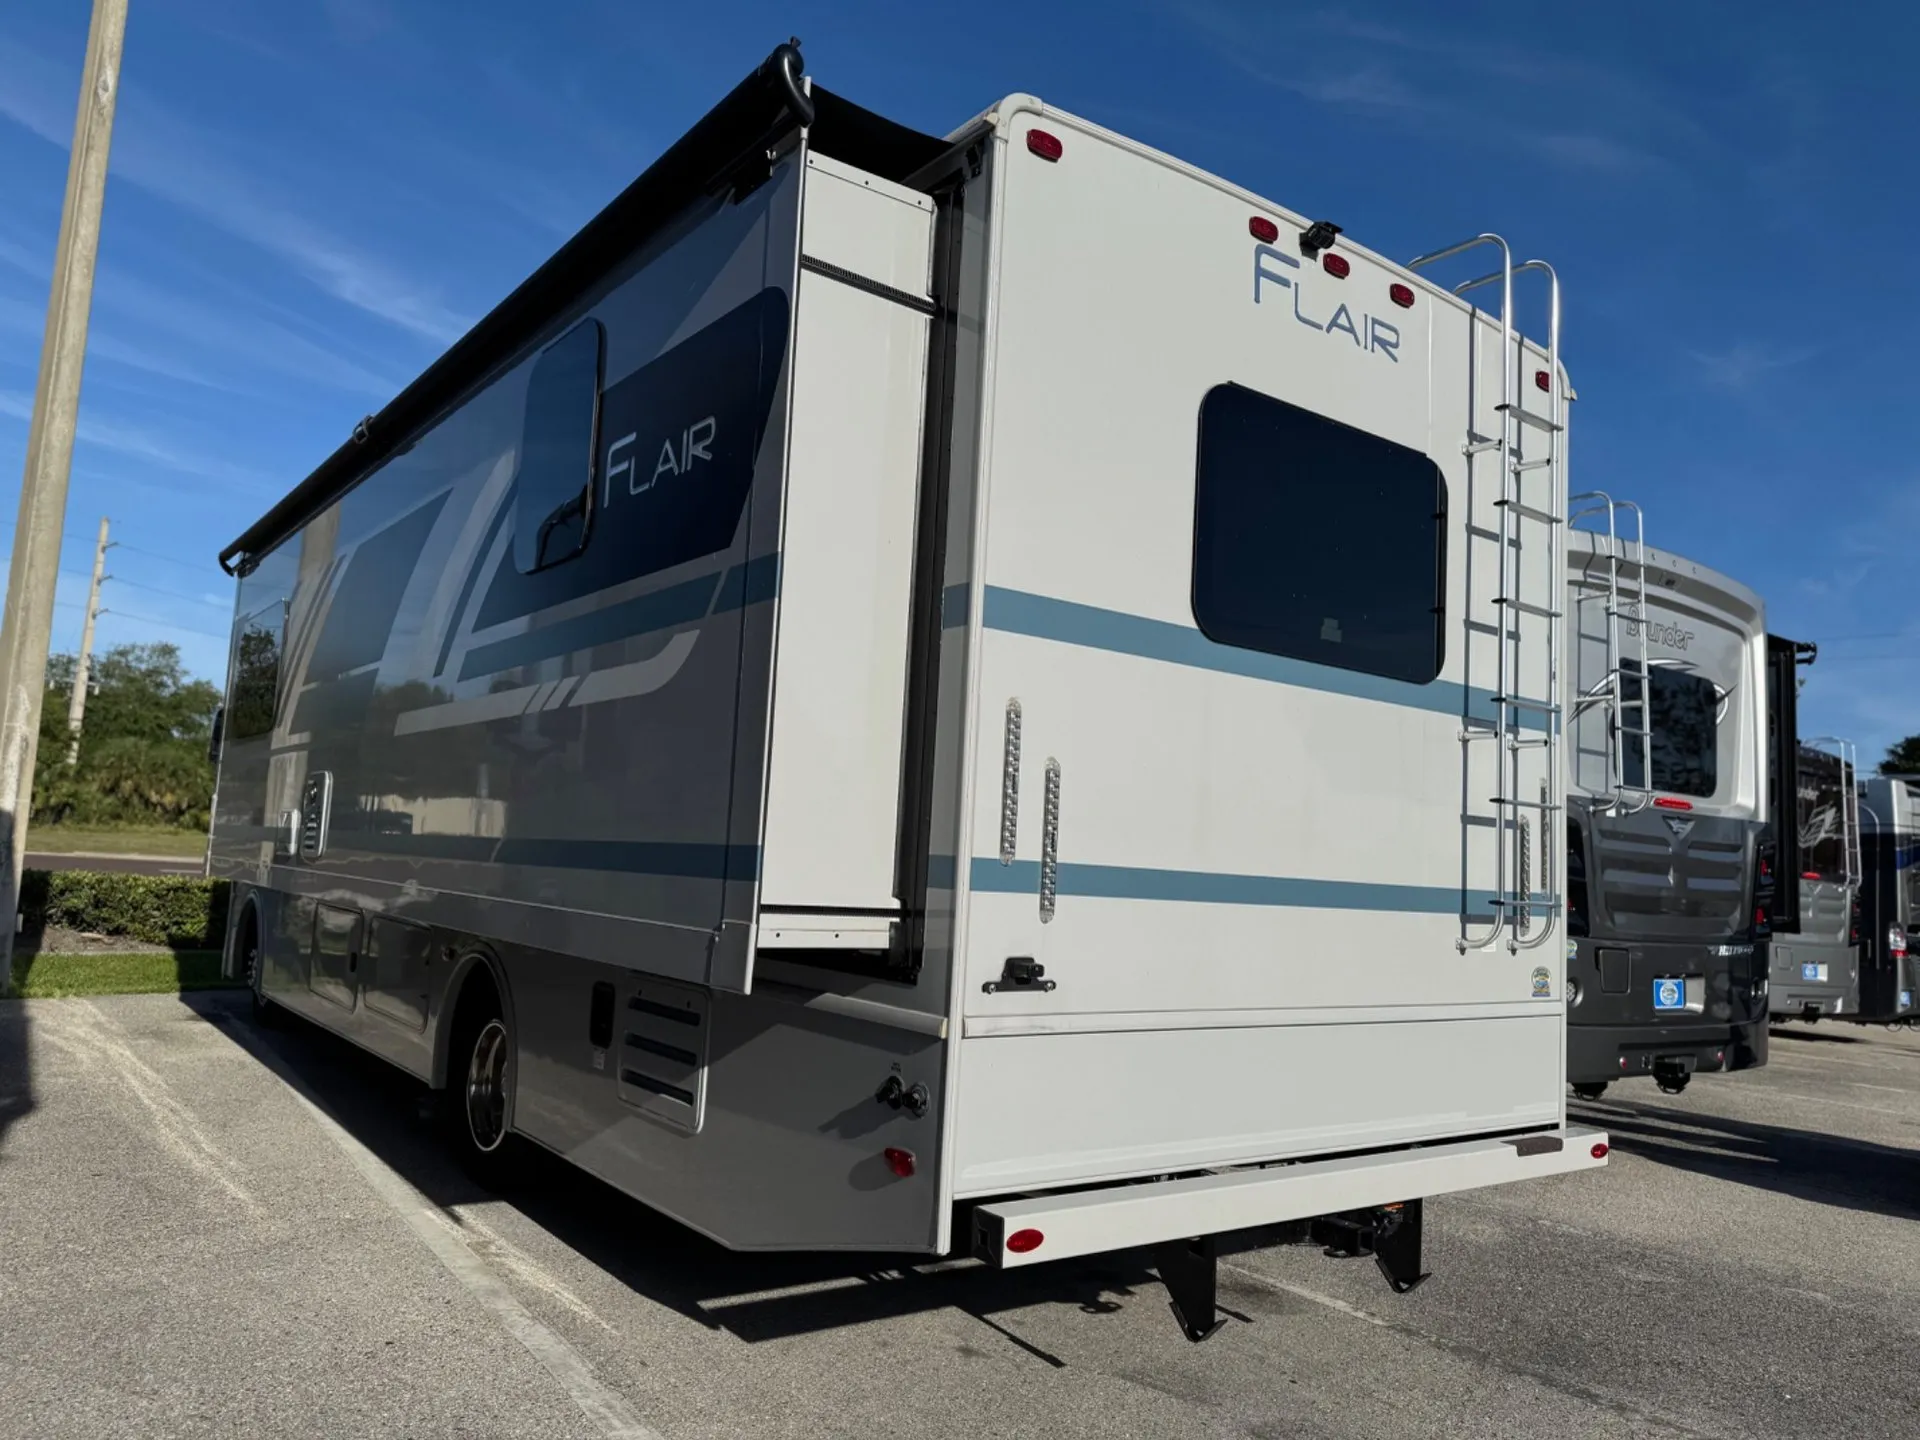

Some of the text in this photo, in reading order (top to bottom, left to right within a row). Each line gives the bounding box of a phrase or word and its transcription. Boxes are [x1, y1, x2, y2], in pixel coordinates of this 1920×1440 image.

[1254, 243, 1400, 363] FLAIR
[603, 416, 716, 508] FLAIR
[1626, 604, 1695, 651] Bunder
